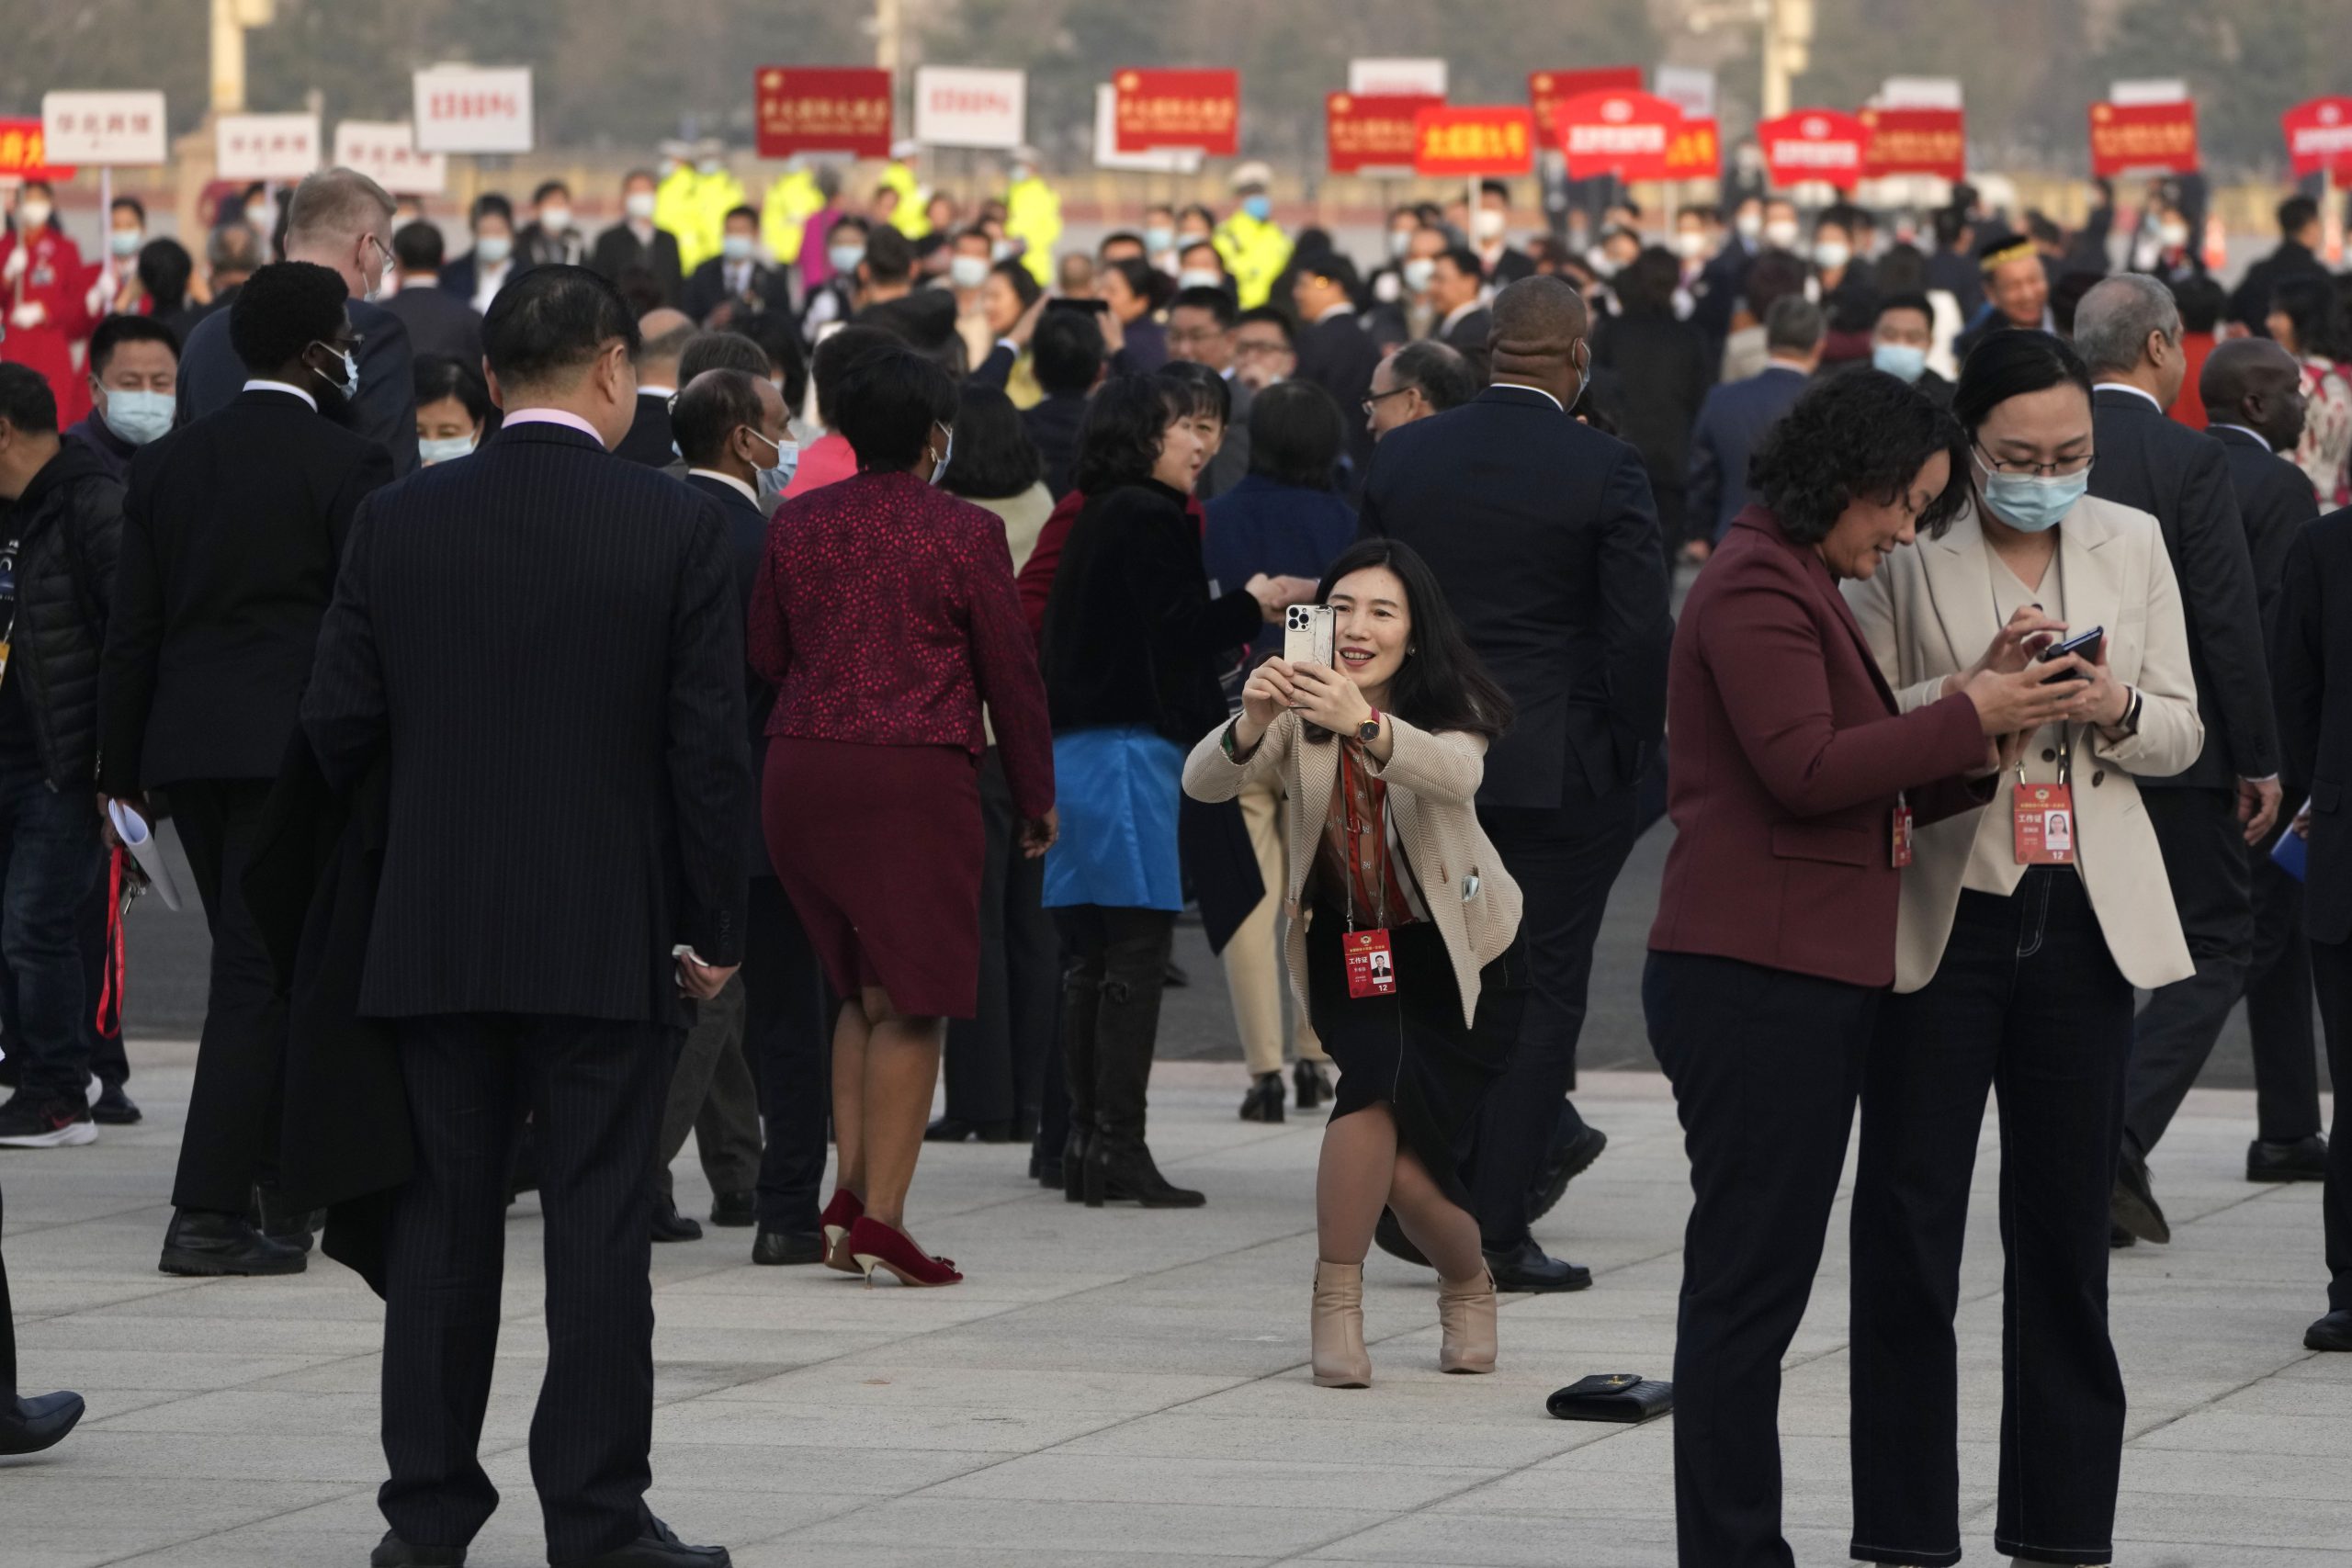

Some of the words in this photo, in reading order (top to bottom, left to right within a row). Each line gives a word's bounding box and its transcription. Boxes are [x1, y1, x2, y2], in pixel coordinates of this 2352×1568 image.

[2052, 851, 2064, 861] 12
[1349, 956, 1369, 964] 工作证
[1378, 984, 1388, 992] 12
